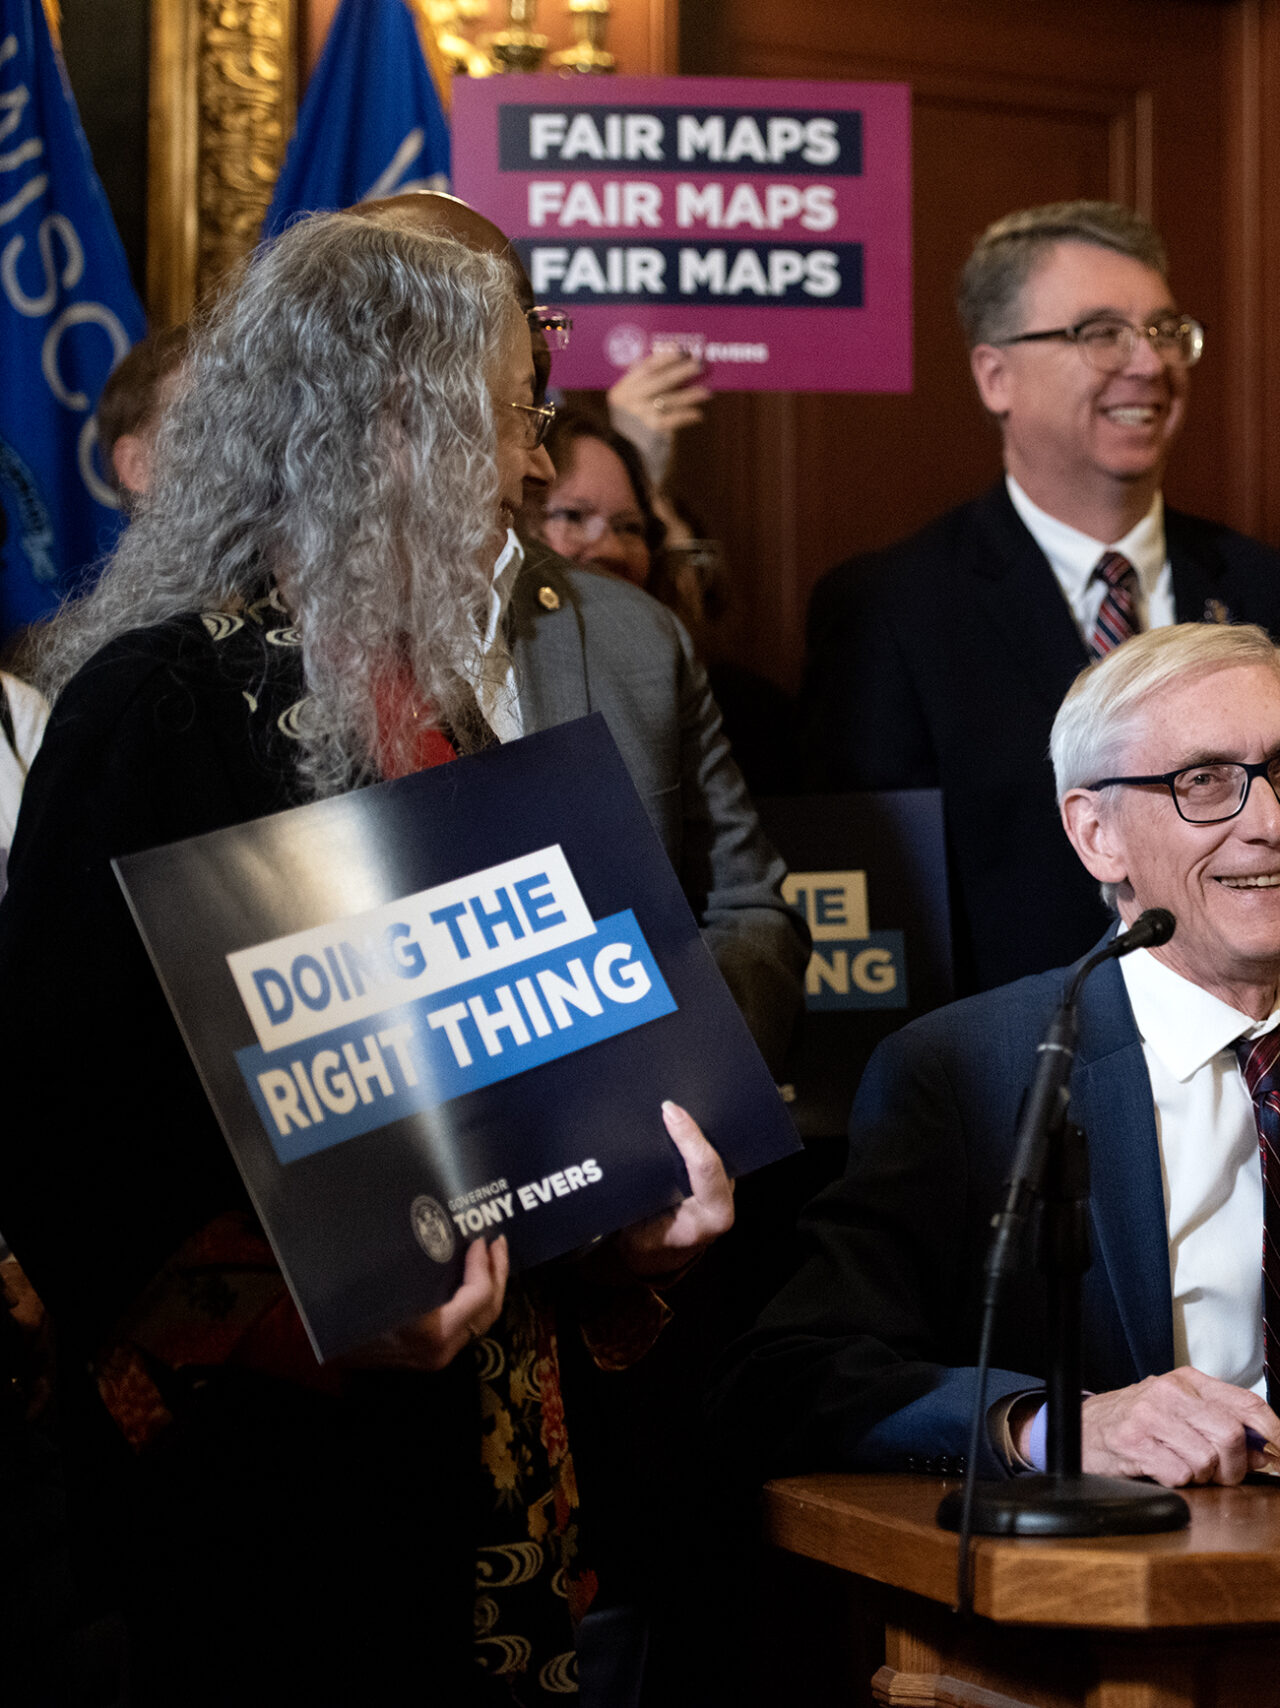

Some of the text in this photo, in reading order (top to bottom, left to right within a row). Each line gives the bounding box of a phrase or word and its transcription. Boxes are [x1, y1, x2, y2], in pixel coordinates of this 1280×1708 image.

[528, 112, 841, 165] FAIR MAPS
[527, 181, 839, 232] FAIR MAPS
[530, 246, 842, 298] FAIR MAPS
[252, 871, 567, 1027] DOING THE
[257, 942, 652, 1137] RIGHT THING
[448, 1178, 509, 1211] GOVERNOR
[453, 1192, 515, 1237] TONY
[516, 1157, 604, 1212] EVERS
